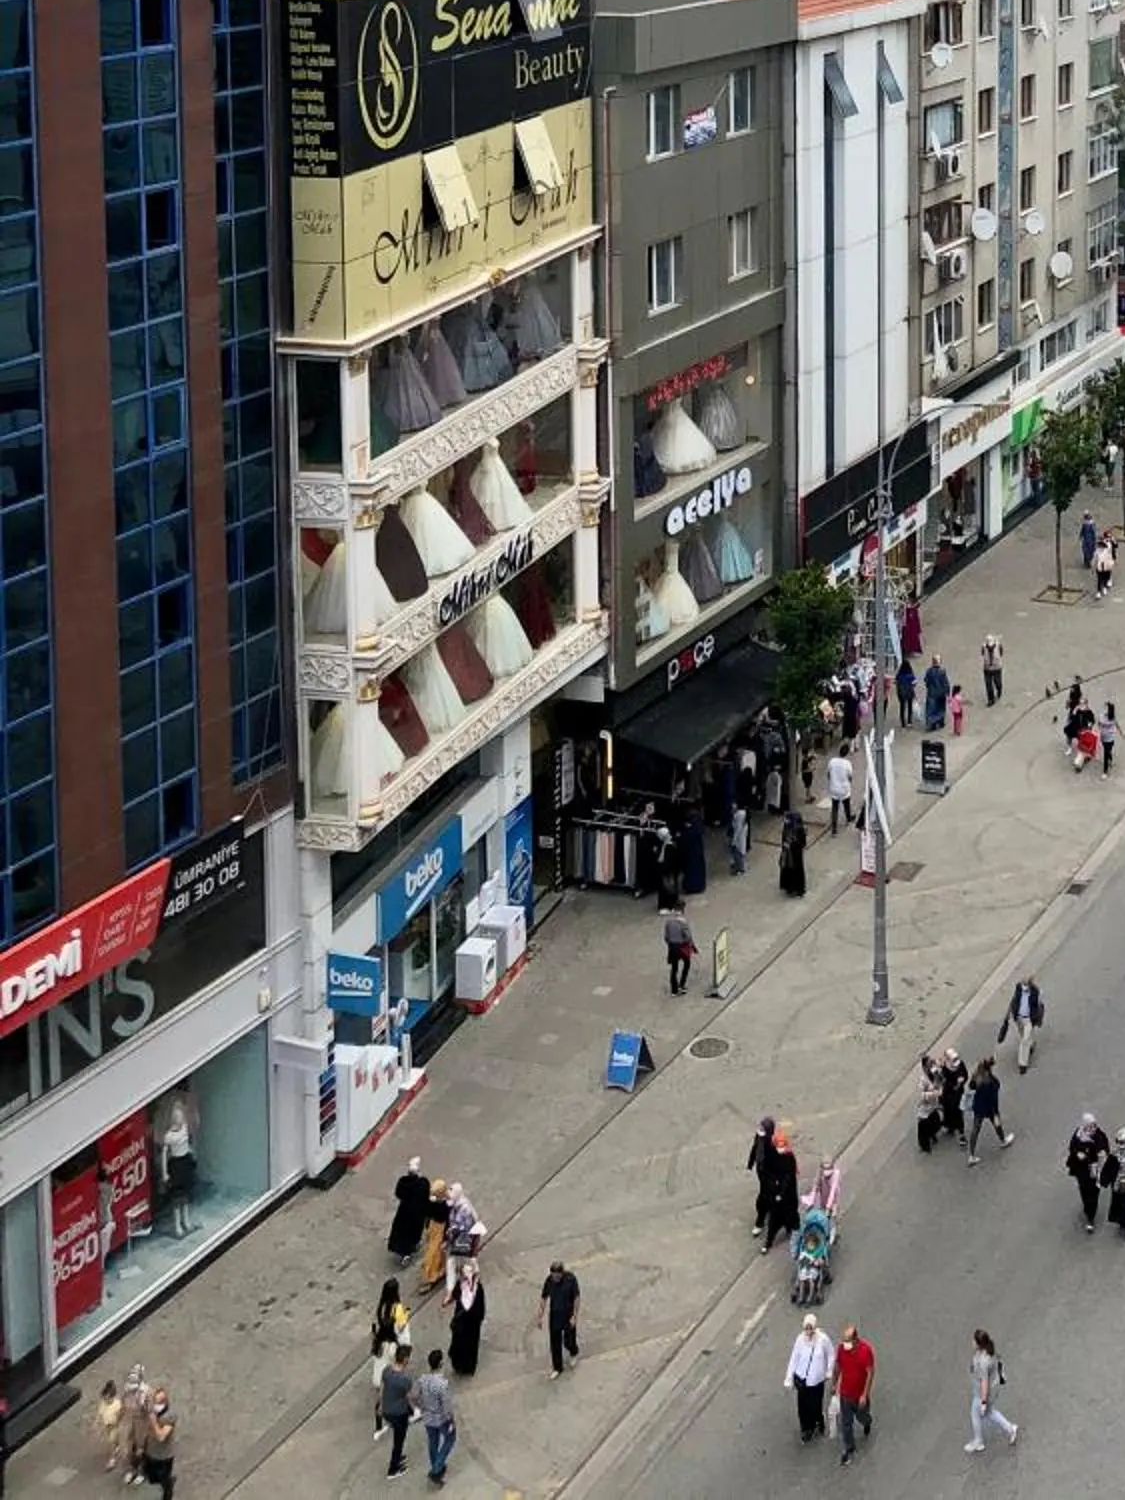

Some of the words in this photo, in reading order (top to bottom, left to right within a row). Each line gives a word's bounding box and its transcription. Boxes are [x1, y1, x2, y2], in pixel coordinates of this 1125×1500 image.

[515, 42, 585, 89] Beauty
[192, 877, 215, 902] 30
[219, 861, 241, 886] 08
[405, 846, 443, 898] beko
[0, 928, 82, 1020] DEMİ
[330, 967, 374, 991] beko
